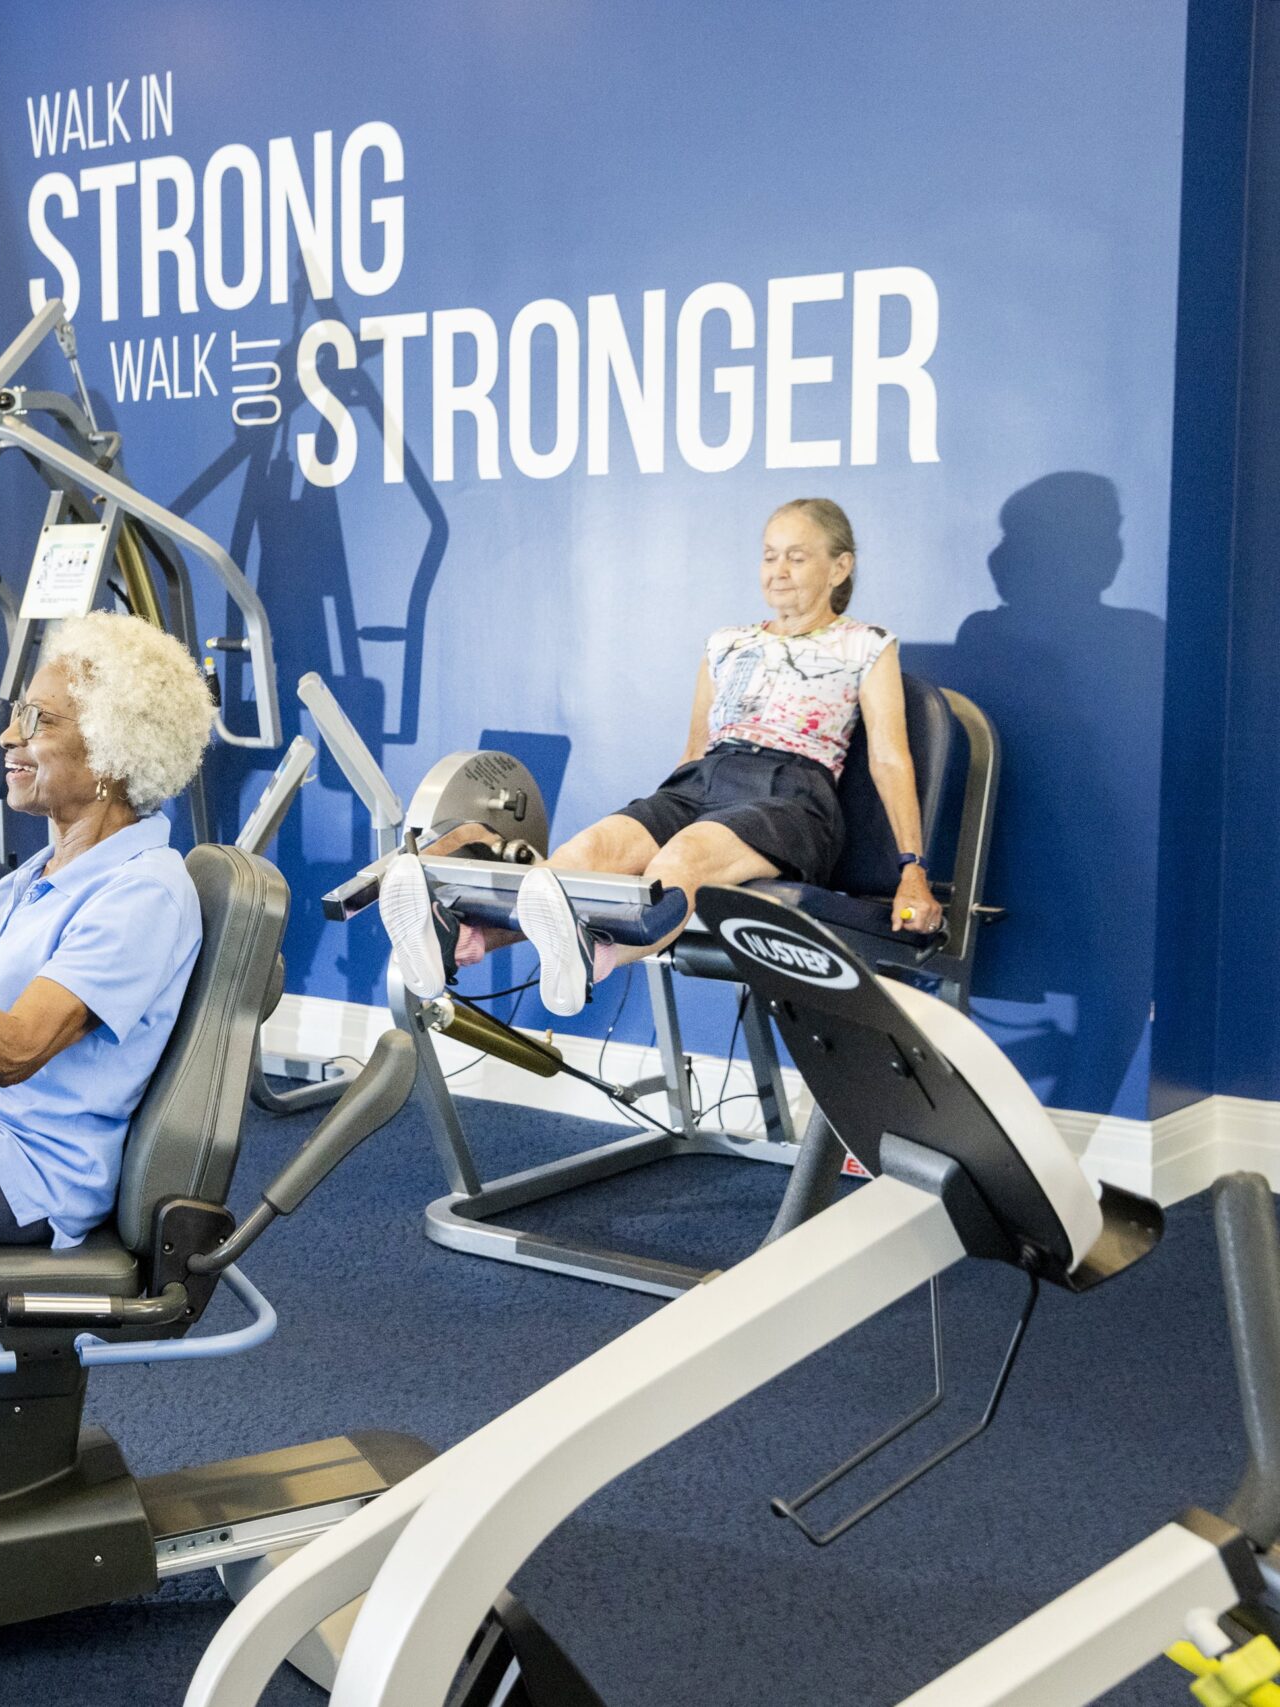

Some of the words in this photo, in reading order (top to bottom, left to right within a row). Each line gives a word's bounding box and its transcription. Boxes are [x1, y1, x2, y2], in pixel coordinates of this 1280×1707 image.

[27, 78, 131, 158] WALK
[141, 71, 173, 141] IN
[28, 121, 404, 322] STRONG
[109, 332, 218, 403] WALK
[231, 330, 282, 427] OUT
[297, 265, 941, 488] STRONGER
[741, 931, 831, 975] NUSTEP
